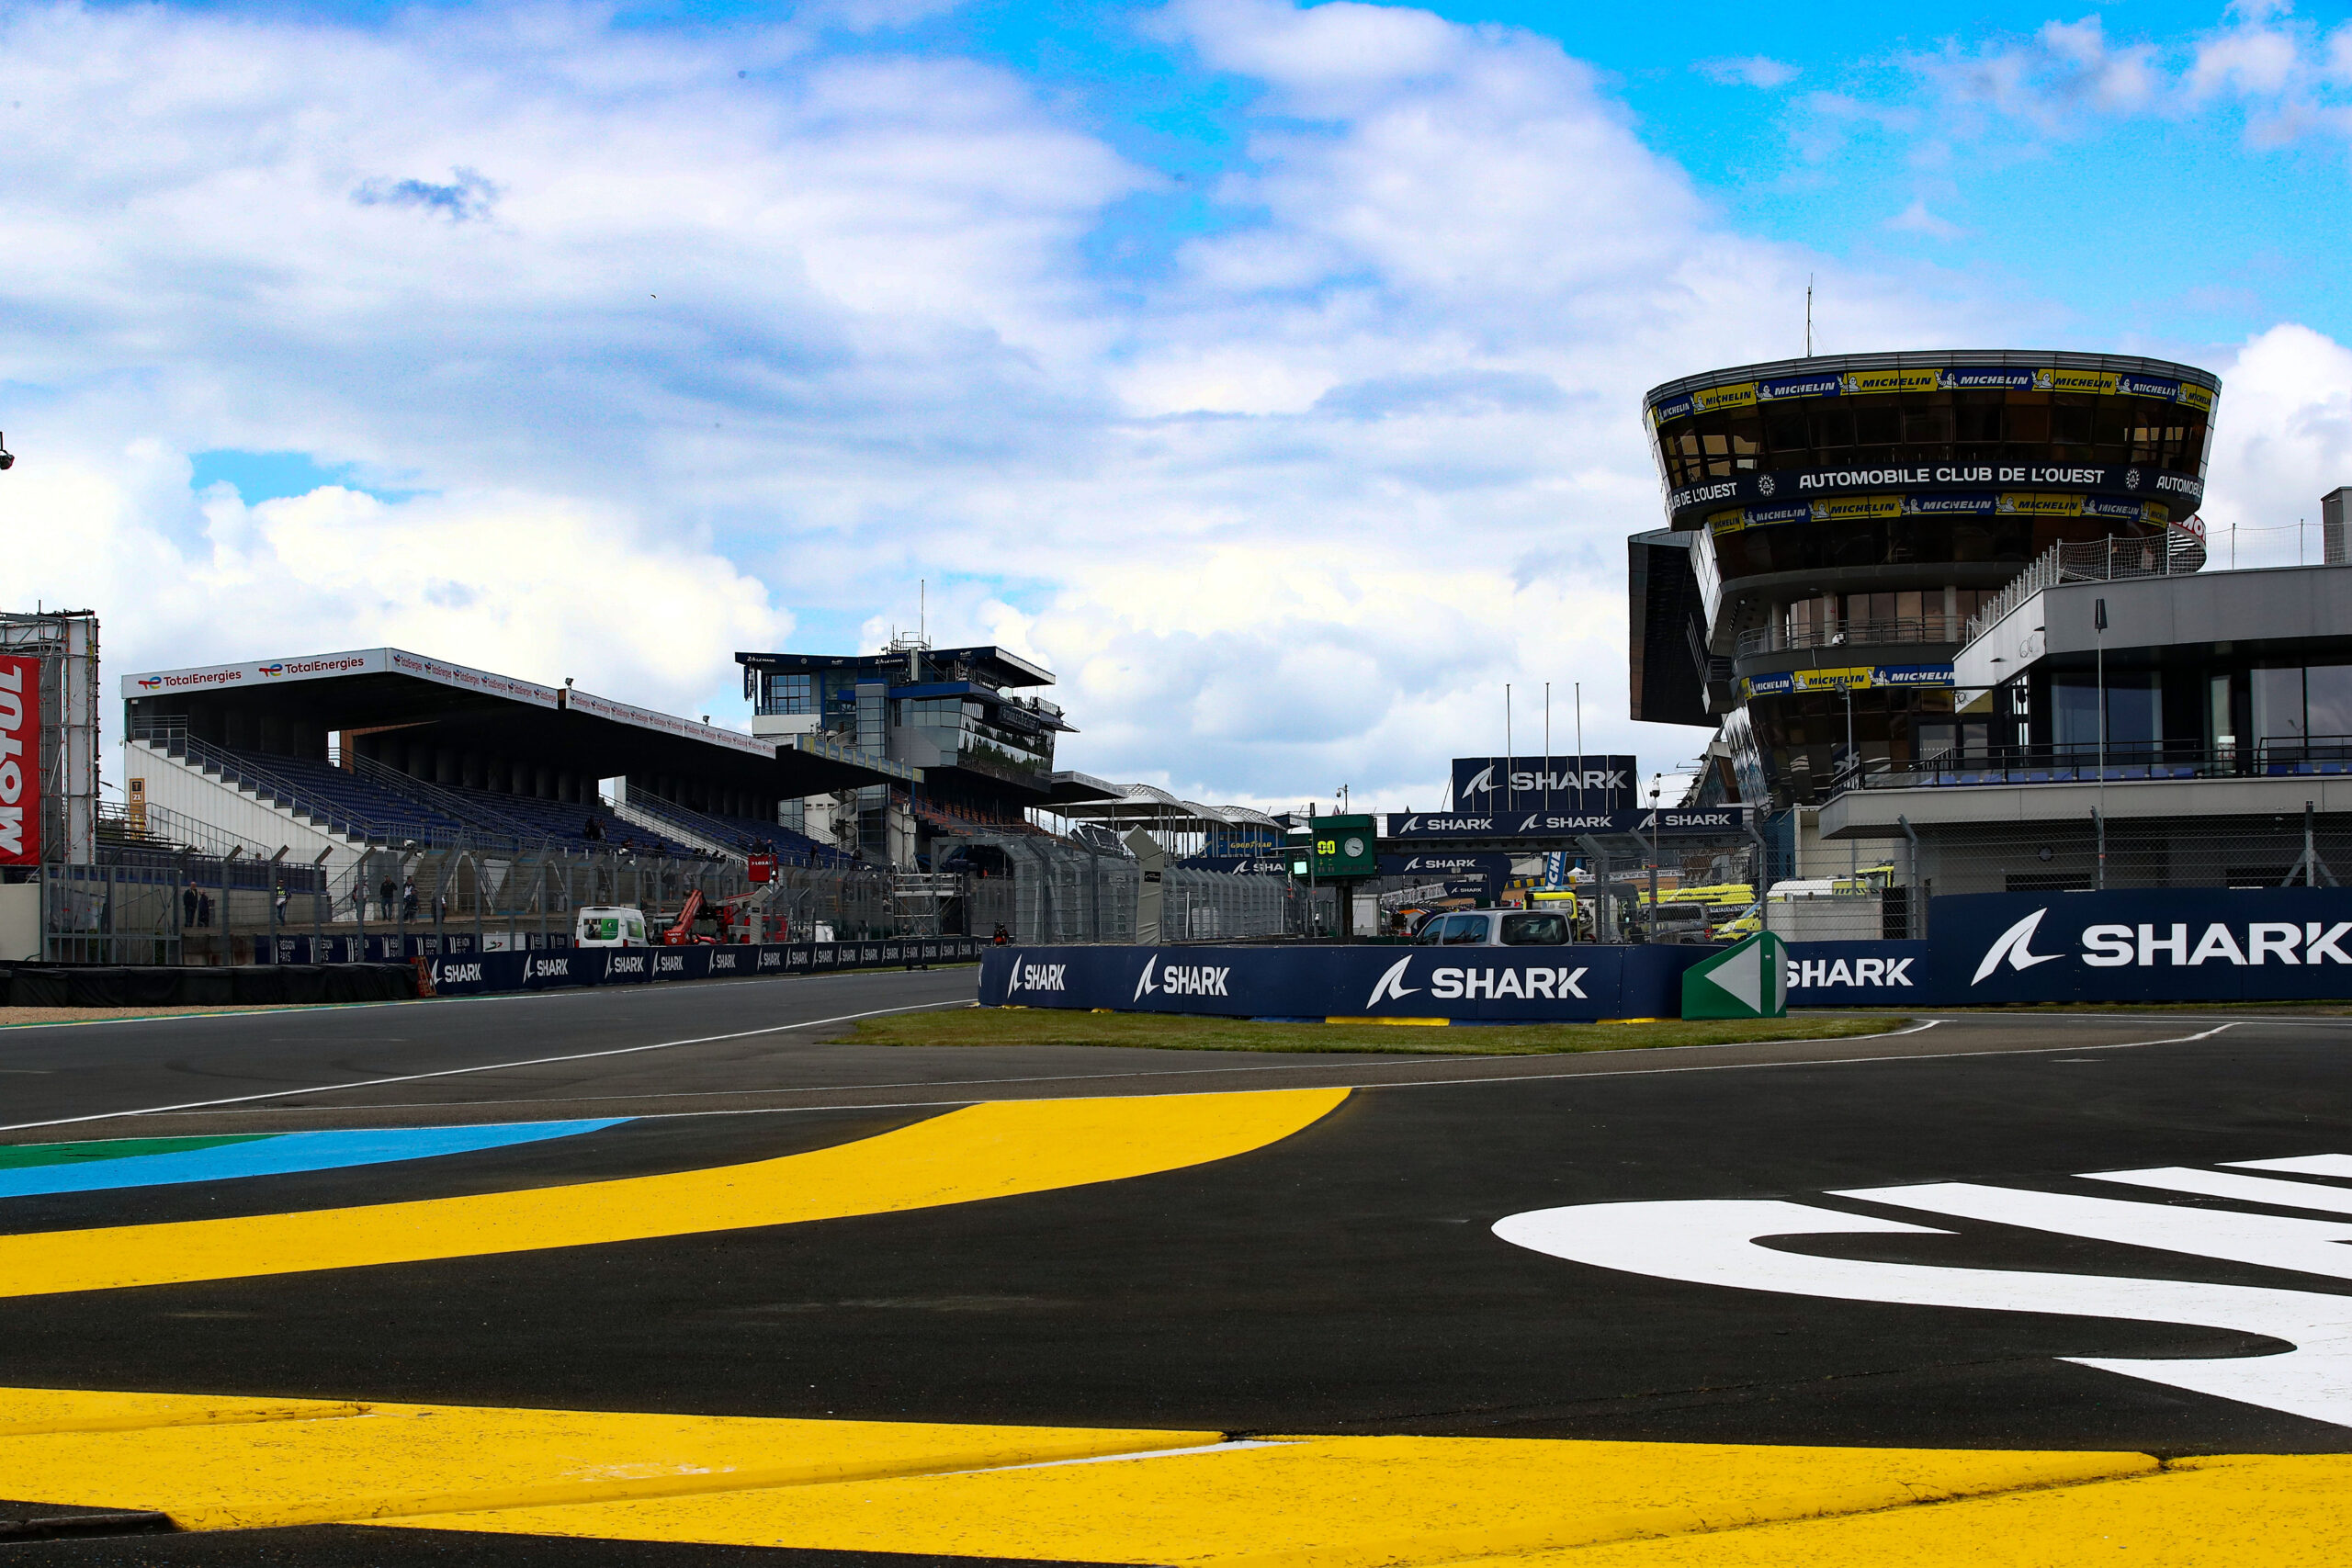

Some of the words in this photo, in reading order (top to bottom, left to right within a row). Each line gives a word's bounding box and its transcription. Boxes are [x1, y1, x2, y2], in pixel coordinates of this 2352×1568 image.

[1862, 377, 1932, 388] MICHELIN
[1960, 376, 2029, 385] MICHELIN
[2054, 377, 2113, 389] MICHELIN
[1774, 382, 1836, 396] MICHELIN
[2132, 383, 2177, 397] MICHELIN
[1706, 391, 1751, 405] MICHELIN
[1799, 468, 1930, 490] AUTOMOBILE
[1936, 468, 1993, 482] CLUB
[1998, 468, 2026, 482] DE
[2031, 468, 2105, 484] L'OUEST
[1680, 491, 1692, 507] DE
[1691, 481, 1737, 503] L'OUEST
[1830, 503, 1895, 514] MICHELIN
[1922, 501, 1992, 510] MICHELIN
[2018, 501, 2078, 511] MICHELIN
[2098, 503, 2140, 515] MICHELIN
[1756, 508, 1806, 522] MICHELIN
[285, 657, 365, 675] TotalEnergies
[164, 671, 242, 687] TotalEnergies
[1755, 680, 1790, 691] MICHELIN
[1808, 674, 1865, 685] MICHELIN
[1510, 770, 1628, 791] SHARK
[1427, 818, 1493, 830] SHARK
[1546, 816, 1612, 828] SHARK
[1665, 813, 1731, 826] SHARK
[1252, 863, 1286, 872] SHA
[1425, 859, 1476, 868] SHARK
[2082, 921, 2352, 966] SHARK
[763, 952, 780, 966] SHARK
[792, 951, 808, 964] SHARK
[818, 950, 833, 963] SHARK
[842, 949, 856, 962] SHARK
[865, 948, 878, 961] SHARK
[886, 947, 899, 959] SHARK
[537, 958, 569, 977] SHARK
[615, 956, 644, 973] SHARK
[661, 955, 684, 972] SHARK
[717, 953, 735, 969] SHARK
[445, 959, 481, 983] SHARK
[1024, 964, 1067, 991] SHARK
[1786, 958, 1915, 987] SHARK
[1163, 965, 1230, 997] SHARK
[1430, 966, 1589, 999] SHARK
